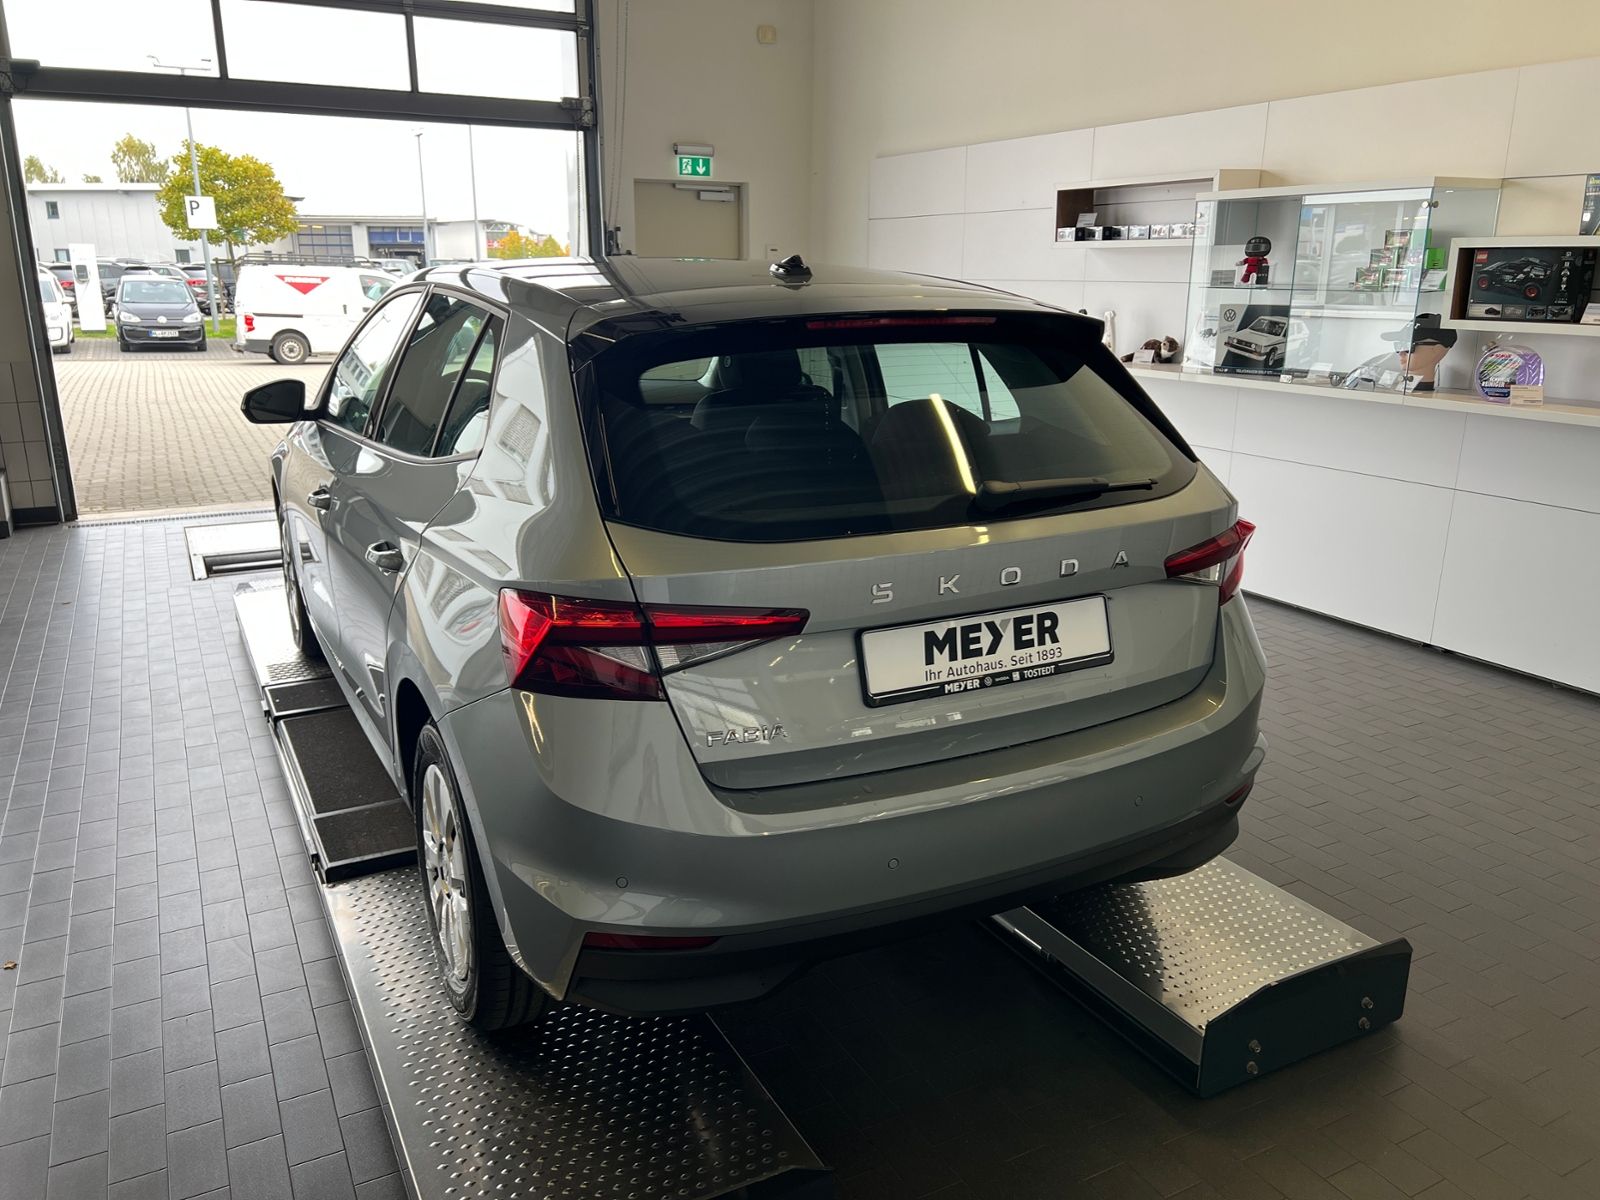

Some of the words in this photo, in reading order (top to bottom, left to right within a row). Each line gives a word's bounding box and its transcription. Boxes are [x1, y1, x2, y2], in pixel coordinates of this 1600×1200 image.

[189, 200, 200, 216] P
[871, 550, 1129, 605] SKODA
[923, 610, 1060, 667] MEYER
[925, 668, 943, 682] Ihr
[946, 658, 1008, 678] Autohaus.
[1010, 652, 1034, 667] Seit
[1036, 646, 1063, 664] 1893
[944, 677, 981, 694] MEYER
[1023, 665, 1056, 679] TOSTEDT
[706, 724, 789, 748] FABIA
